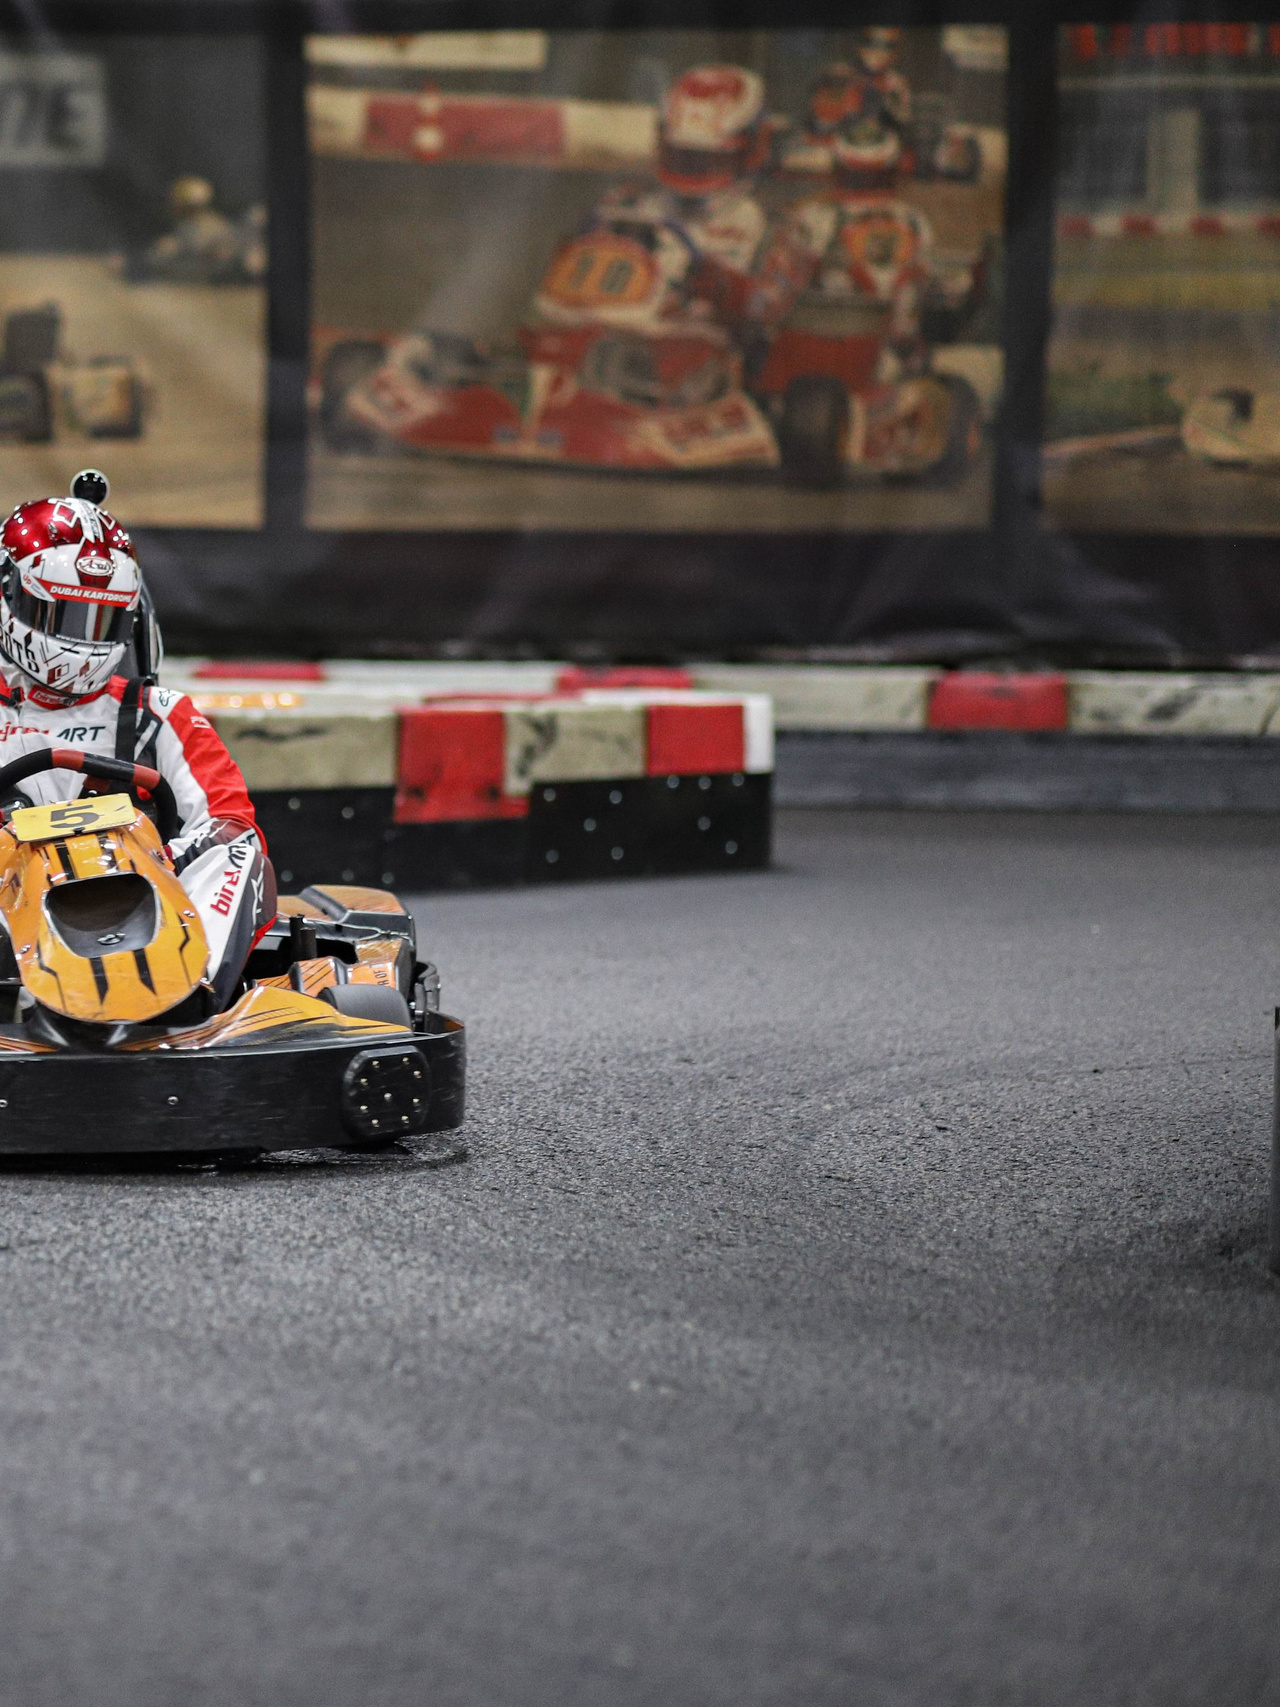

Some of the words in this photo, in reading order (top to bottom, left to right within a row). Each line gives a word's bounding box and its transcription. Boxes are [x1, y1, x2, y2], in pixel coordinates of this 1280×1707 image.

[50, 585, 82, 597] DUBAI
[82, 590, 133, 603] KARTDROME
[56, 726, 106, 742] ART
[50, 804, 101, 829] 5
